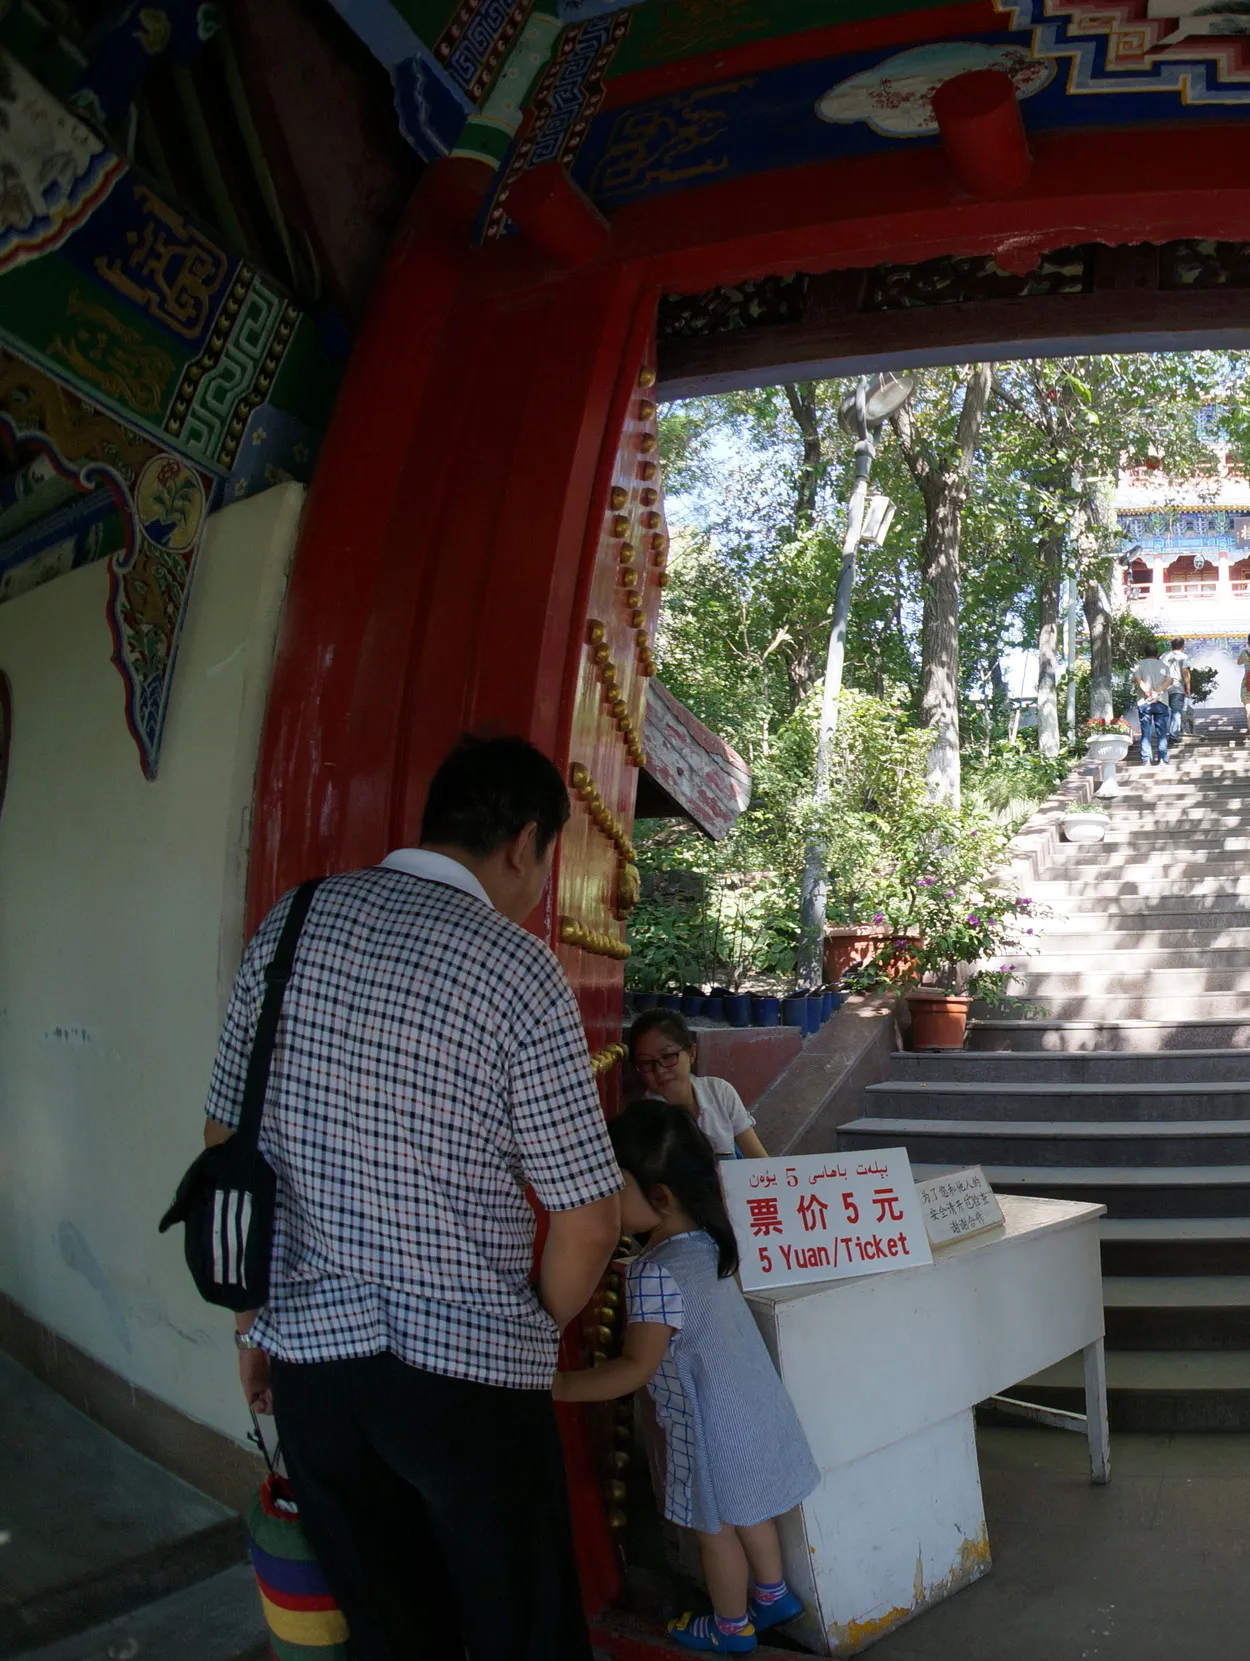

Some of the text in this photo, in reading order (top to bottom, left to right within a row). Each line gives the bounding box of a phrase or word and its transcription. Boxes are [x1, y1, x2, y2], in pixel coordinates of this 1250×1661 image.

[785, 1167, 799, 1187] 5
[746, 1188, 904, 1237] 票价5元
[950, 1211, 985, 1234] 谢谢合作
[758, 1232, 910, 1273] 5 Yuan/Ticket
